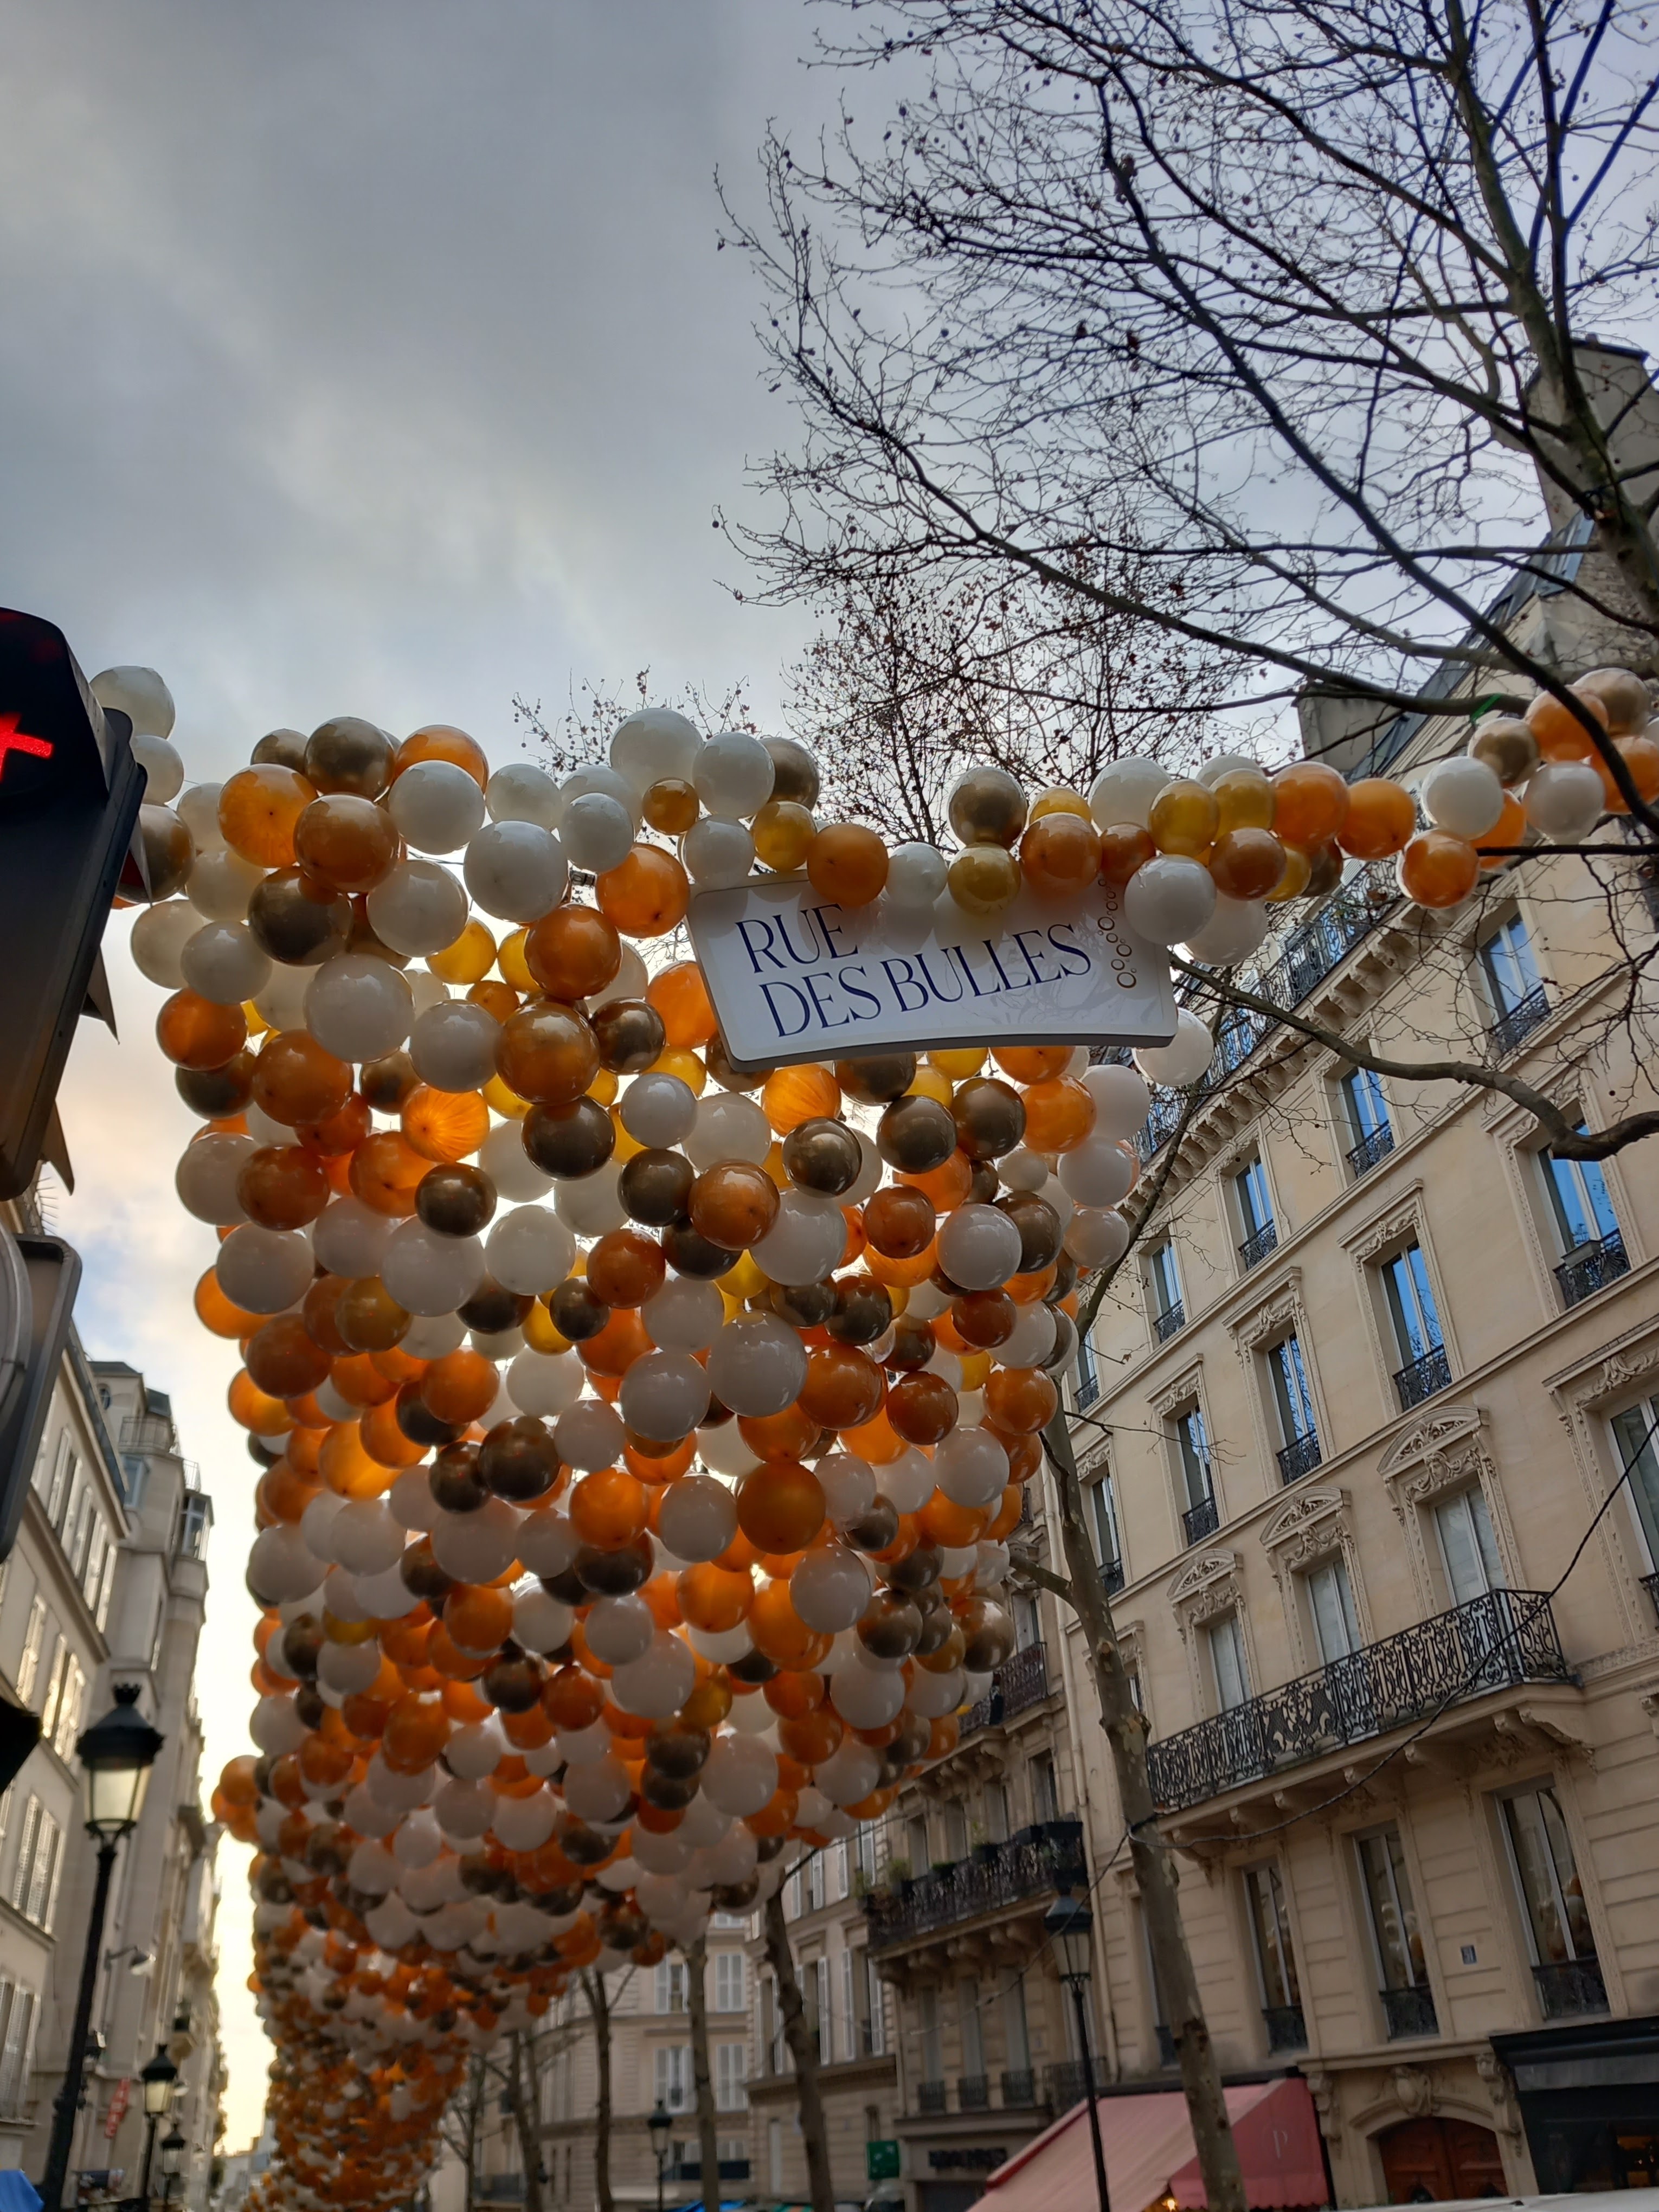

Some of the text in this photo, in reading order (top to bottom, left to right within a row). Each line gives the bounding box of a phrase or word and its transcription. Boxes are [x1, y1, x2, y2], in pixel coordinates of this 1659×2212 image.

[735, 903, 859, 974] RUE
[758, 923, 1091, 1038] DES BULLES
